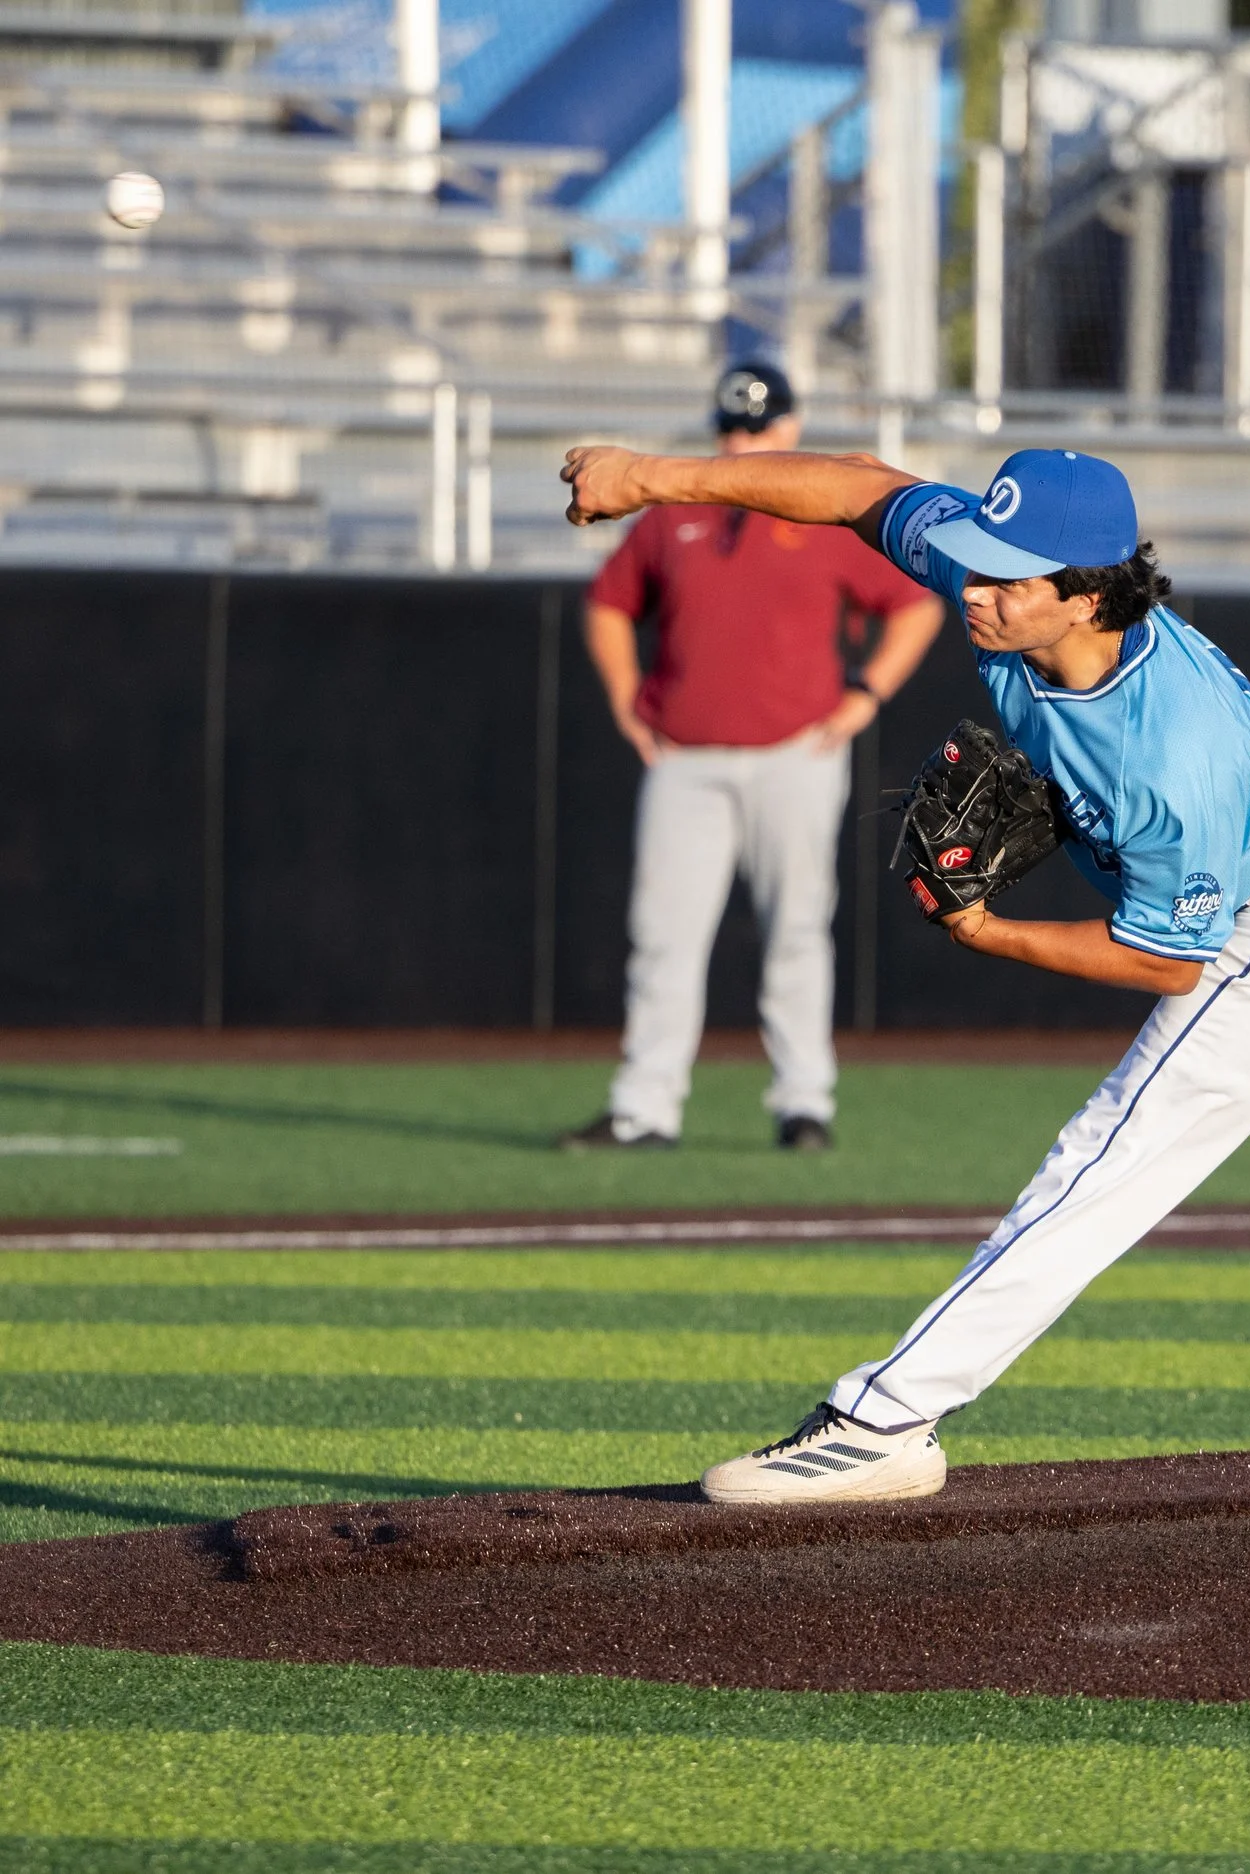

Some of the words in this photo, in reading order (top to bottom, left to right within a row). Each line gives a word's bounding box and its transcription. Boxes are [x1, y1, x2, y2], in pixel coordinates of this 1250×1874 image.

[926, 497, 943, 513] WEST
[980, 475, 1022, 524] D
[911, 512, 927, 536] COAST
